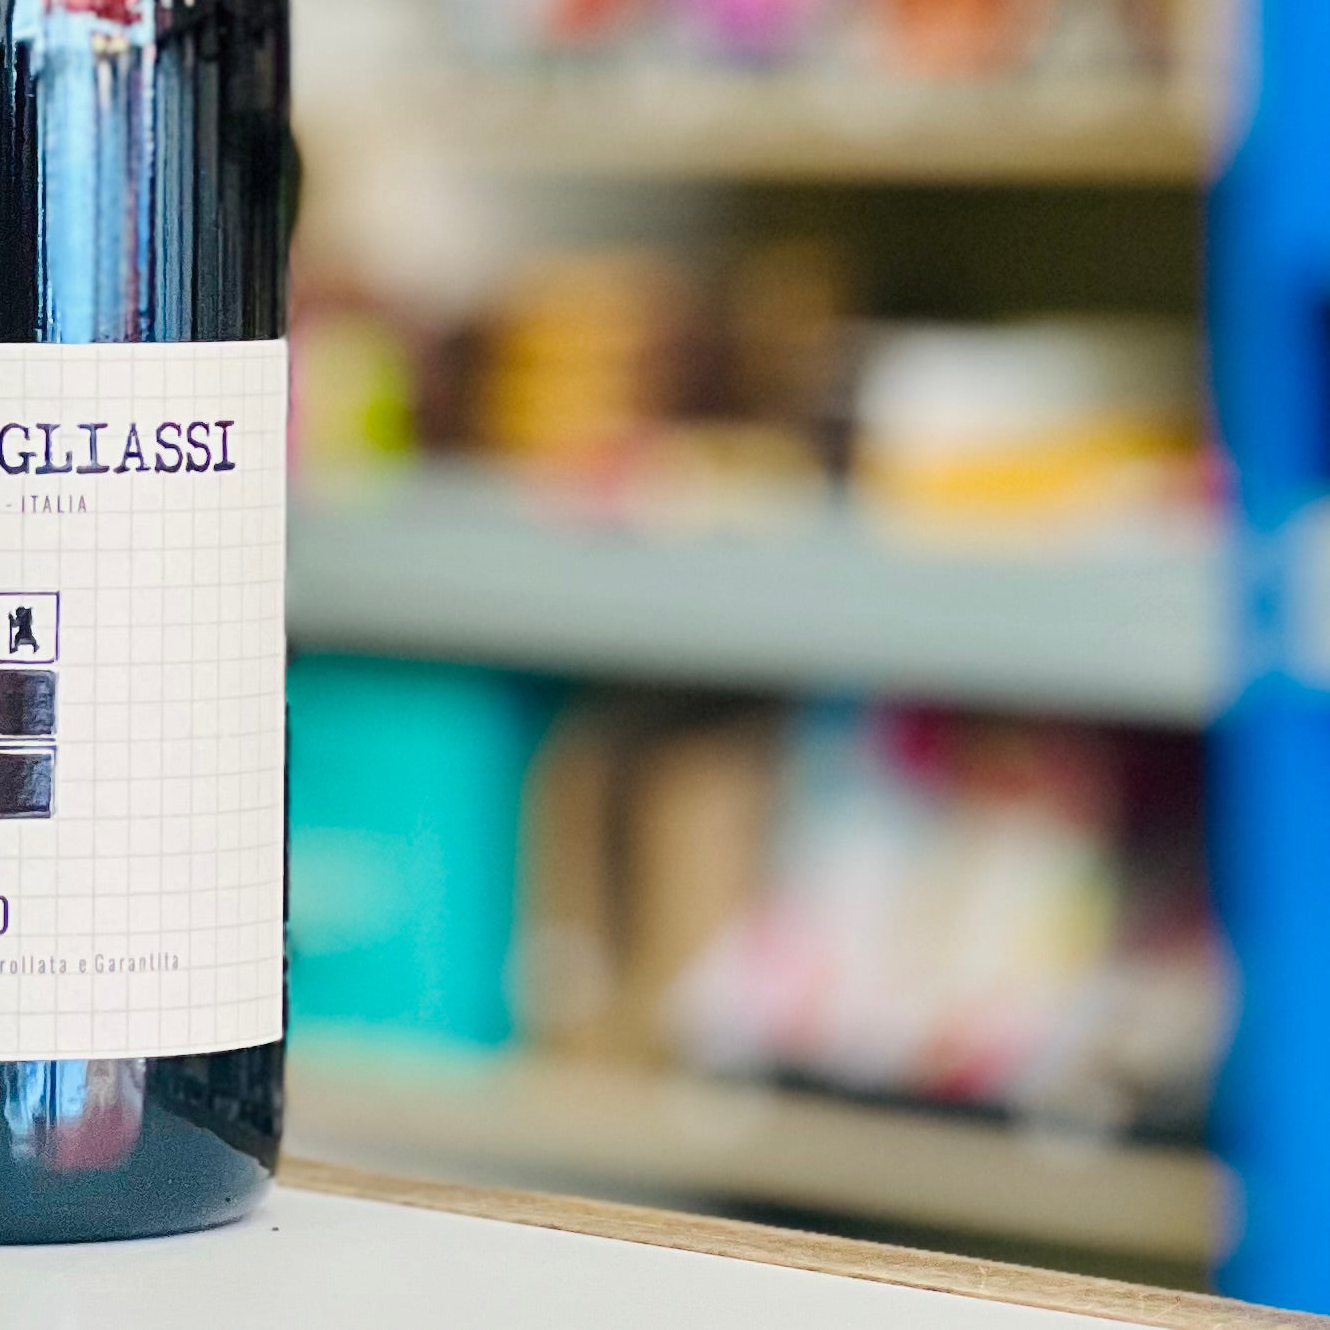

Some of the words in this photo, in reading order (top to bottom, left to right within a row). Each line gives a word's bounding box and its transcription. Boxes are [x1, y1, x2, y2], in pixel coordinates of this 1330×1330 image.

[21, 494, 87, 514] ITALIA
[78, 957, 88, 973] e
[94, 951, 180, 974] Garantita
